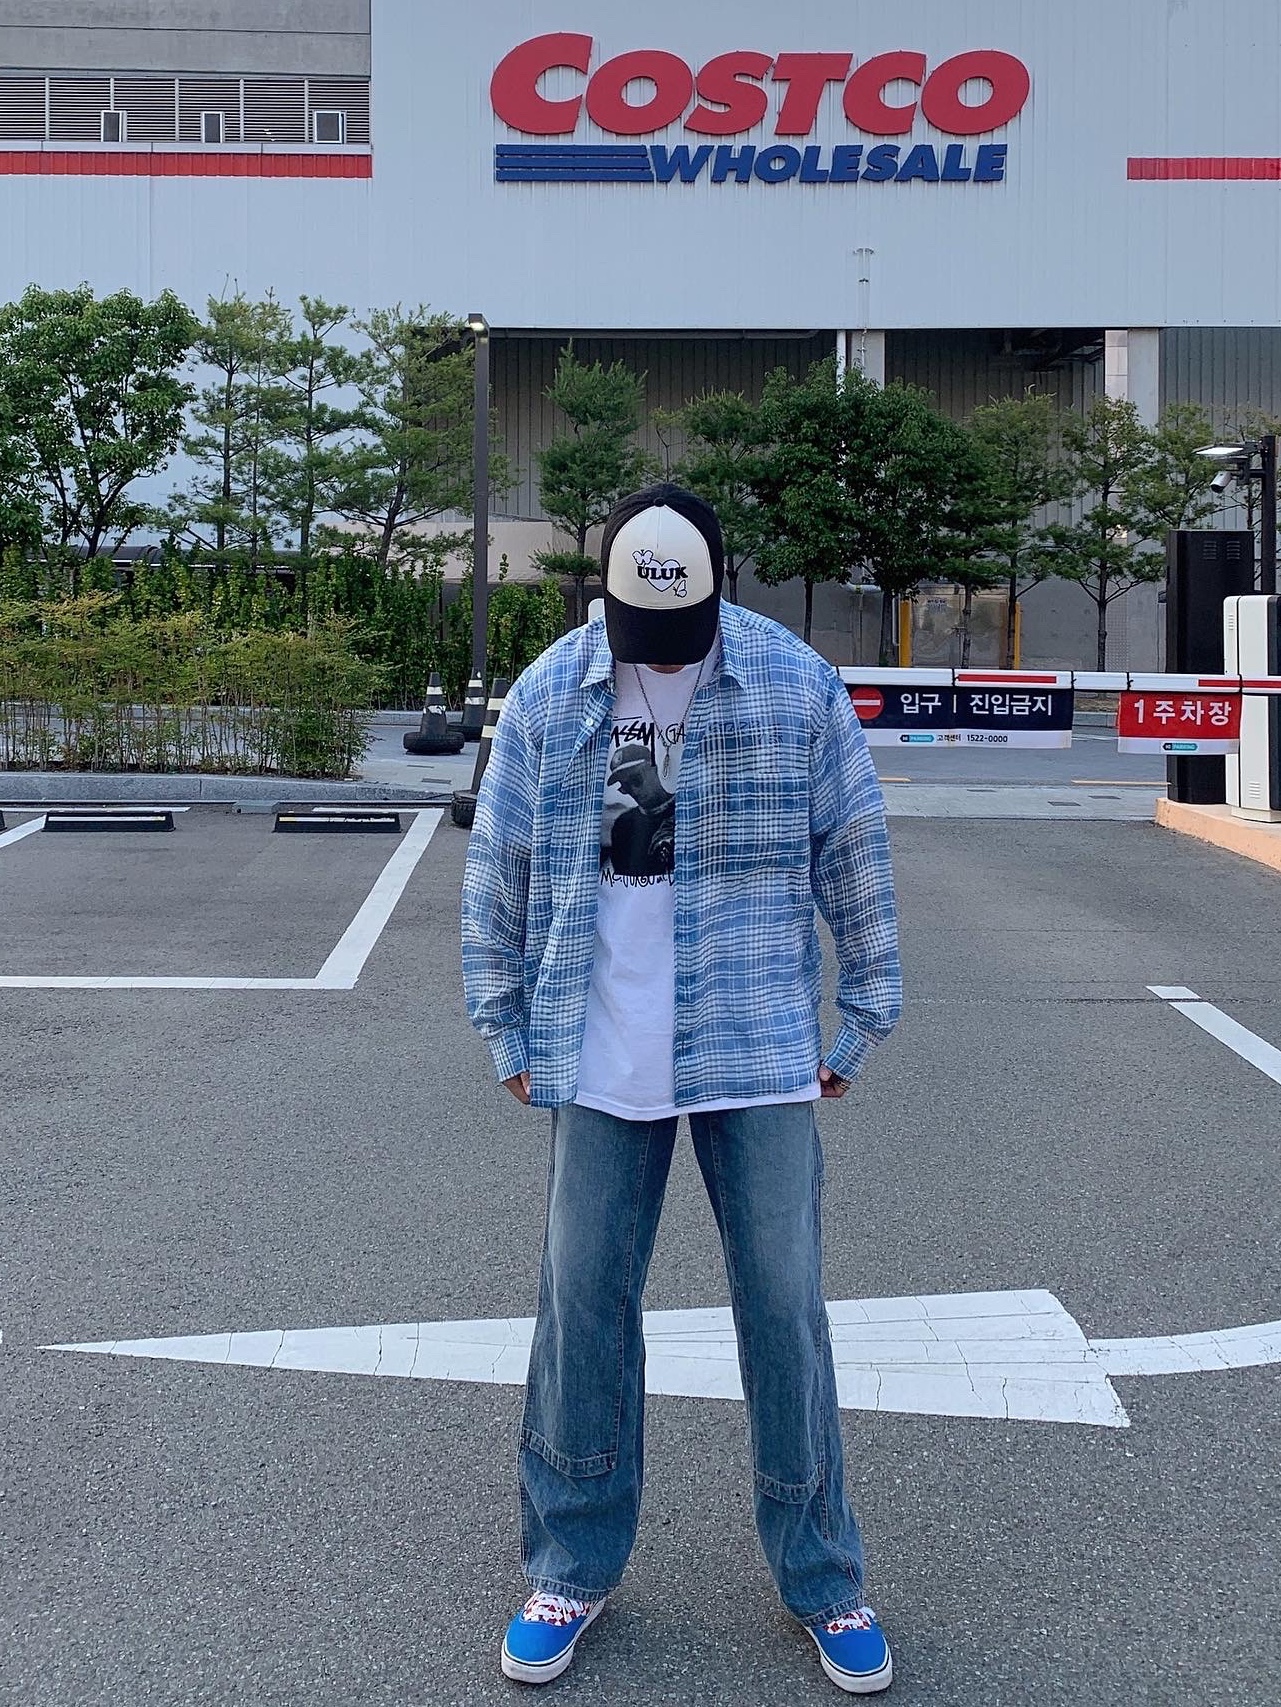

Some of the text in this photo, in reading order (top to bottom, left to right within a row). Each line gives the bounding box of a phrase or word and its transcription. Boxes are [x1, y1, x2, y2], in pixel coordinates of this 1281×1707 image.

[490, 32, 1031, 135] COSTCO
[646, 144, 1008, 183] WHOLESALE
[637, 565, 688, 580] ULUK
[900, 692, 1053, 716] 입구 진입금지
[966, 734, 1009, 743] 1522-0000
